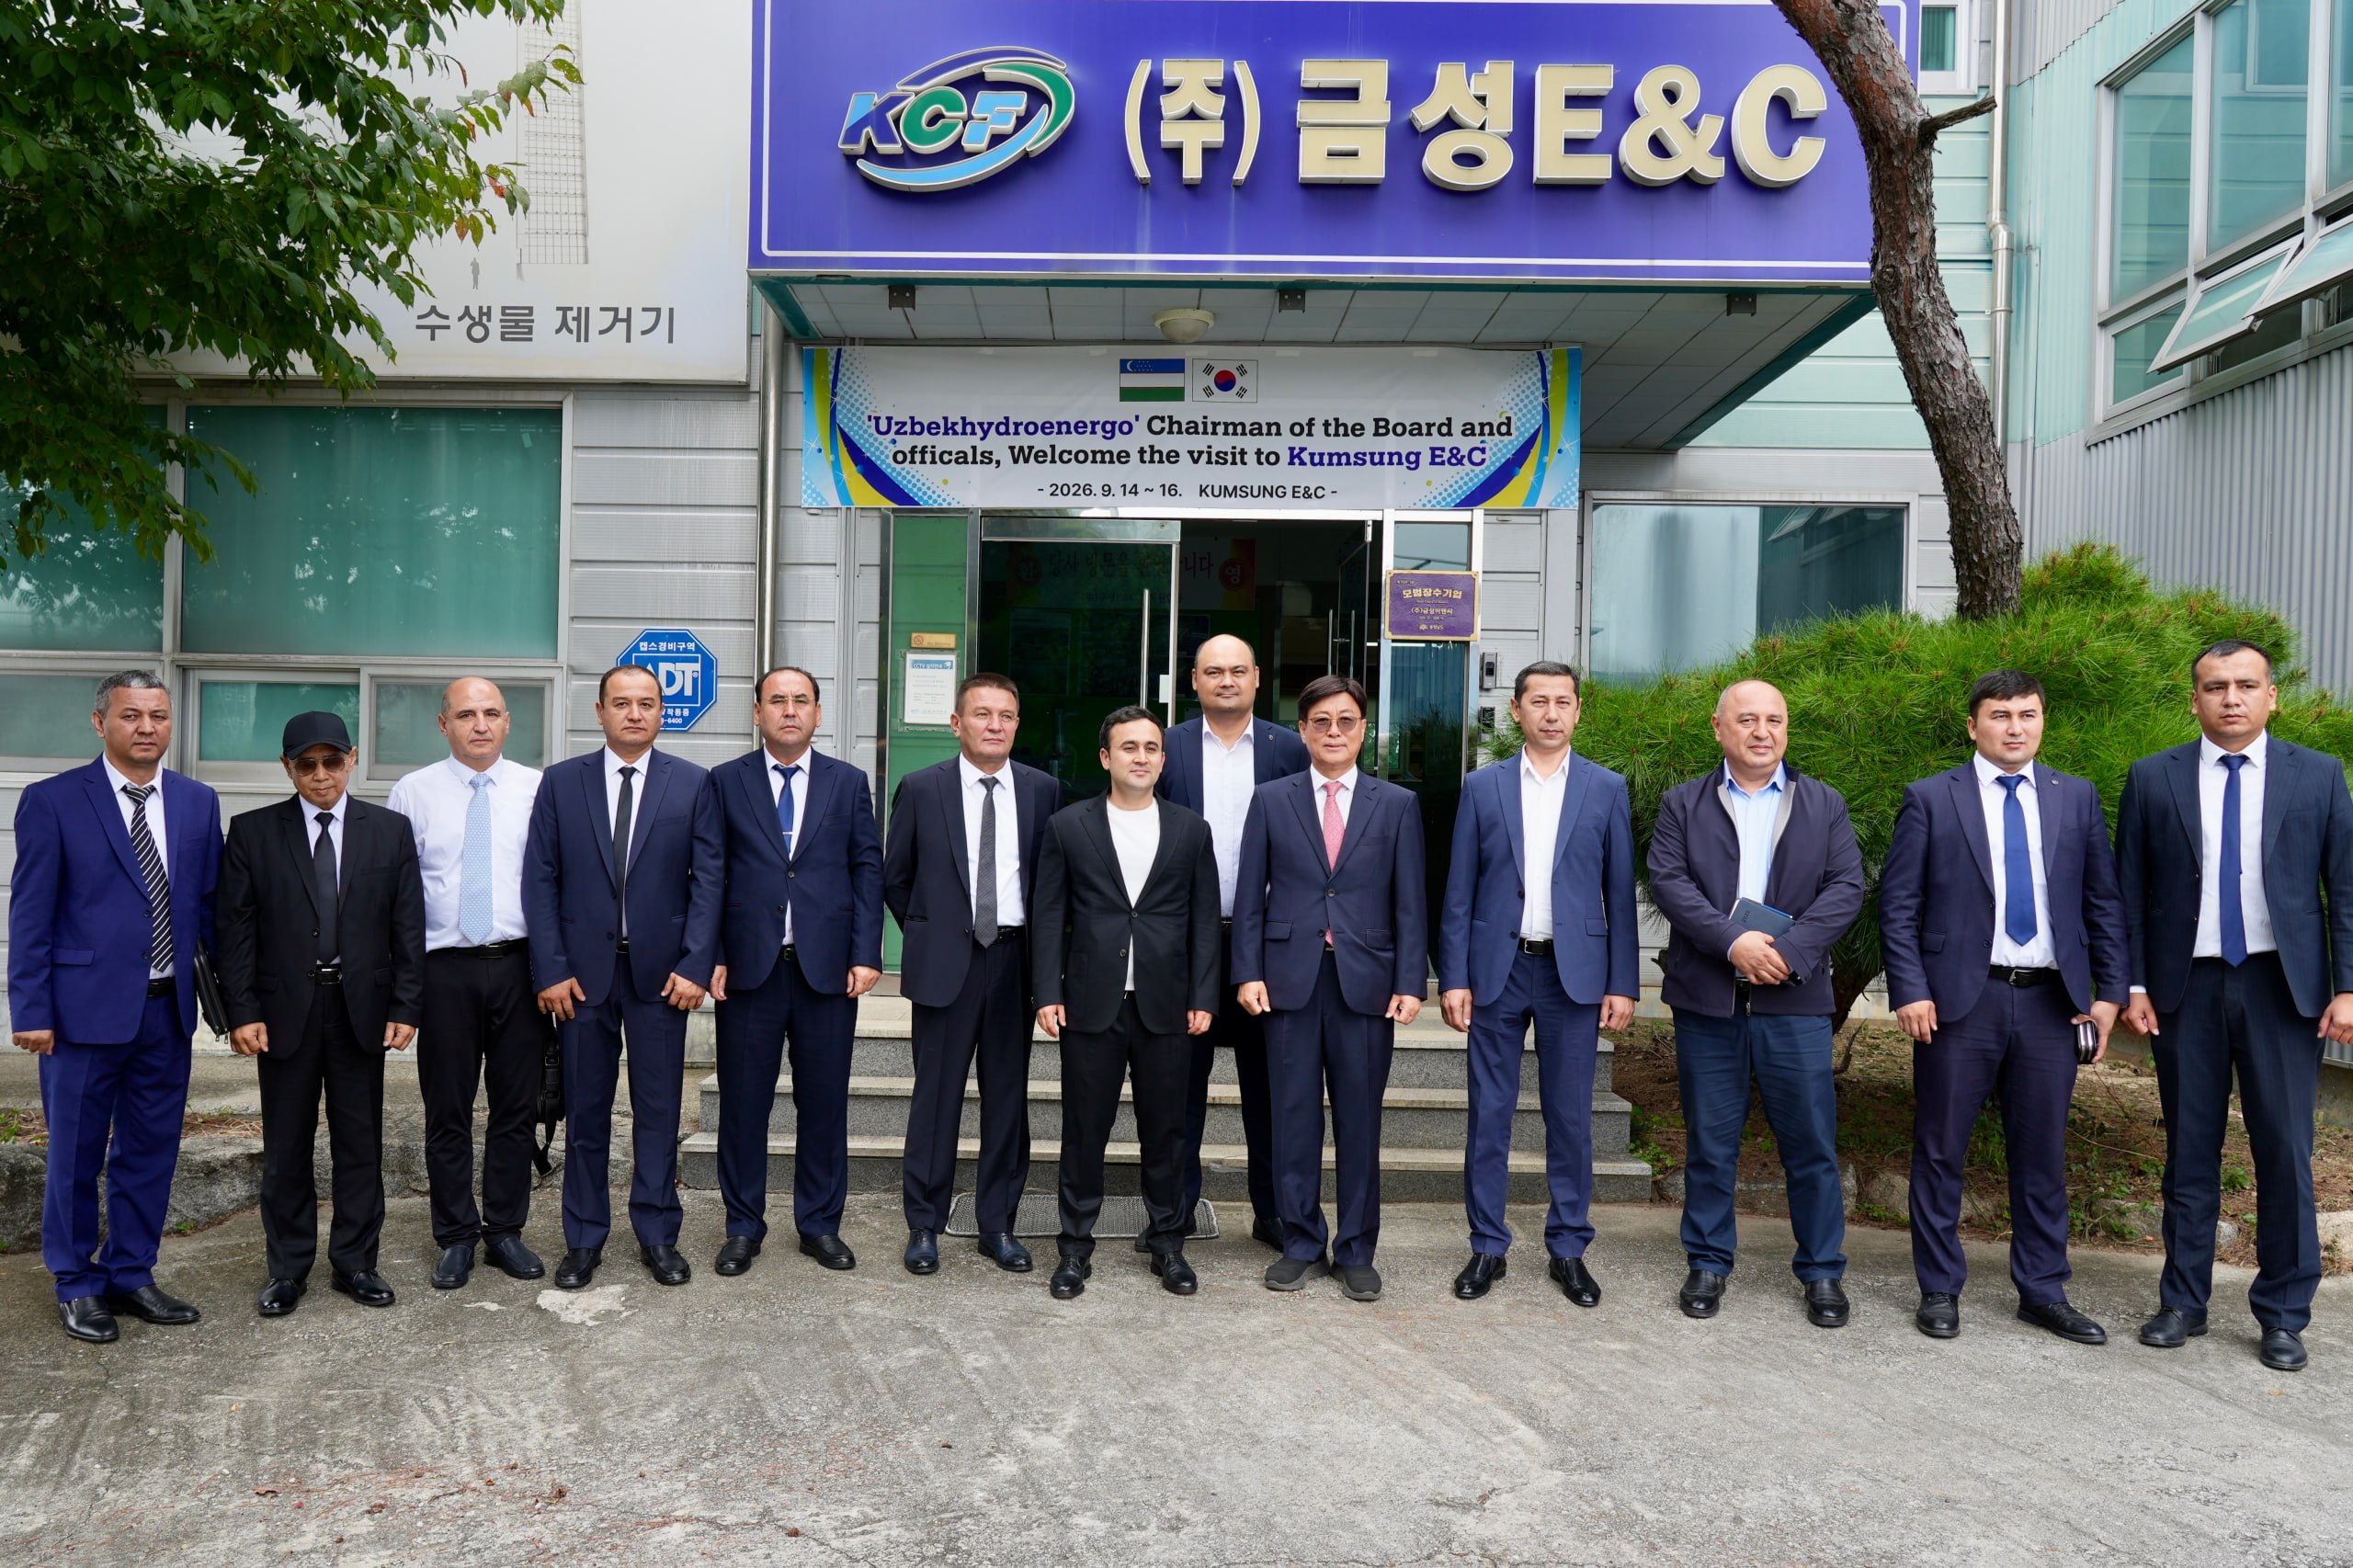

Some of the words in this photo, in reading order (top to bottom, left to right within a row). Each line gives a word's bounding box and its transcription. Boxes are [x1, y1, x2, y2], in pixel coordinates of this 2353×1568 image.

[838, 86, 1028, 154] KCF
[415, 304, 535, 344] 수생물
[554, 306, 675, 344] 제거기
[867, 415, 1140, 440] 'Uzbekhydroenergo'
[1146, 415, 1283, 437] Chairman
[1289, 416, 1316, 437] of
[1322, 417, 1366, 437] the
[1372, 416, 1454, 437] Board
[1461, 415, 1513, 437] and
[892, 445, 1002, 470] officals,
[1007, 445, 1131, 465] Welcome
[1137, 445, 1180, 465] the
[1187, 445, 1248, 466] visit
[1254, 448, 1280, 466] to
[1287, 446, 1422, 472] Kumsung
[1428, 446, 1486, 467] E&C
[1049, 483, 1097, 497] 2026.
[1101, 483, 1116, 497] 9.
[1120, 483, 1140, 497] 14
[1159, 483, 1183, 497] 16.
[1199, 483, 1287, 499] KUMSUNG
[1291, 485, 1325, 499] E&C
[1225, 563, 1243, 585] 영
[1403, 588, 1462, 599] 모범장수기업
[639, 642, 696, 652] 캡스경비구역
